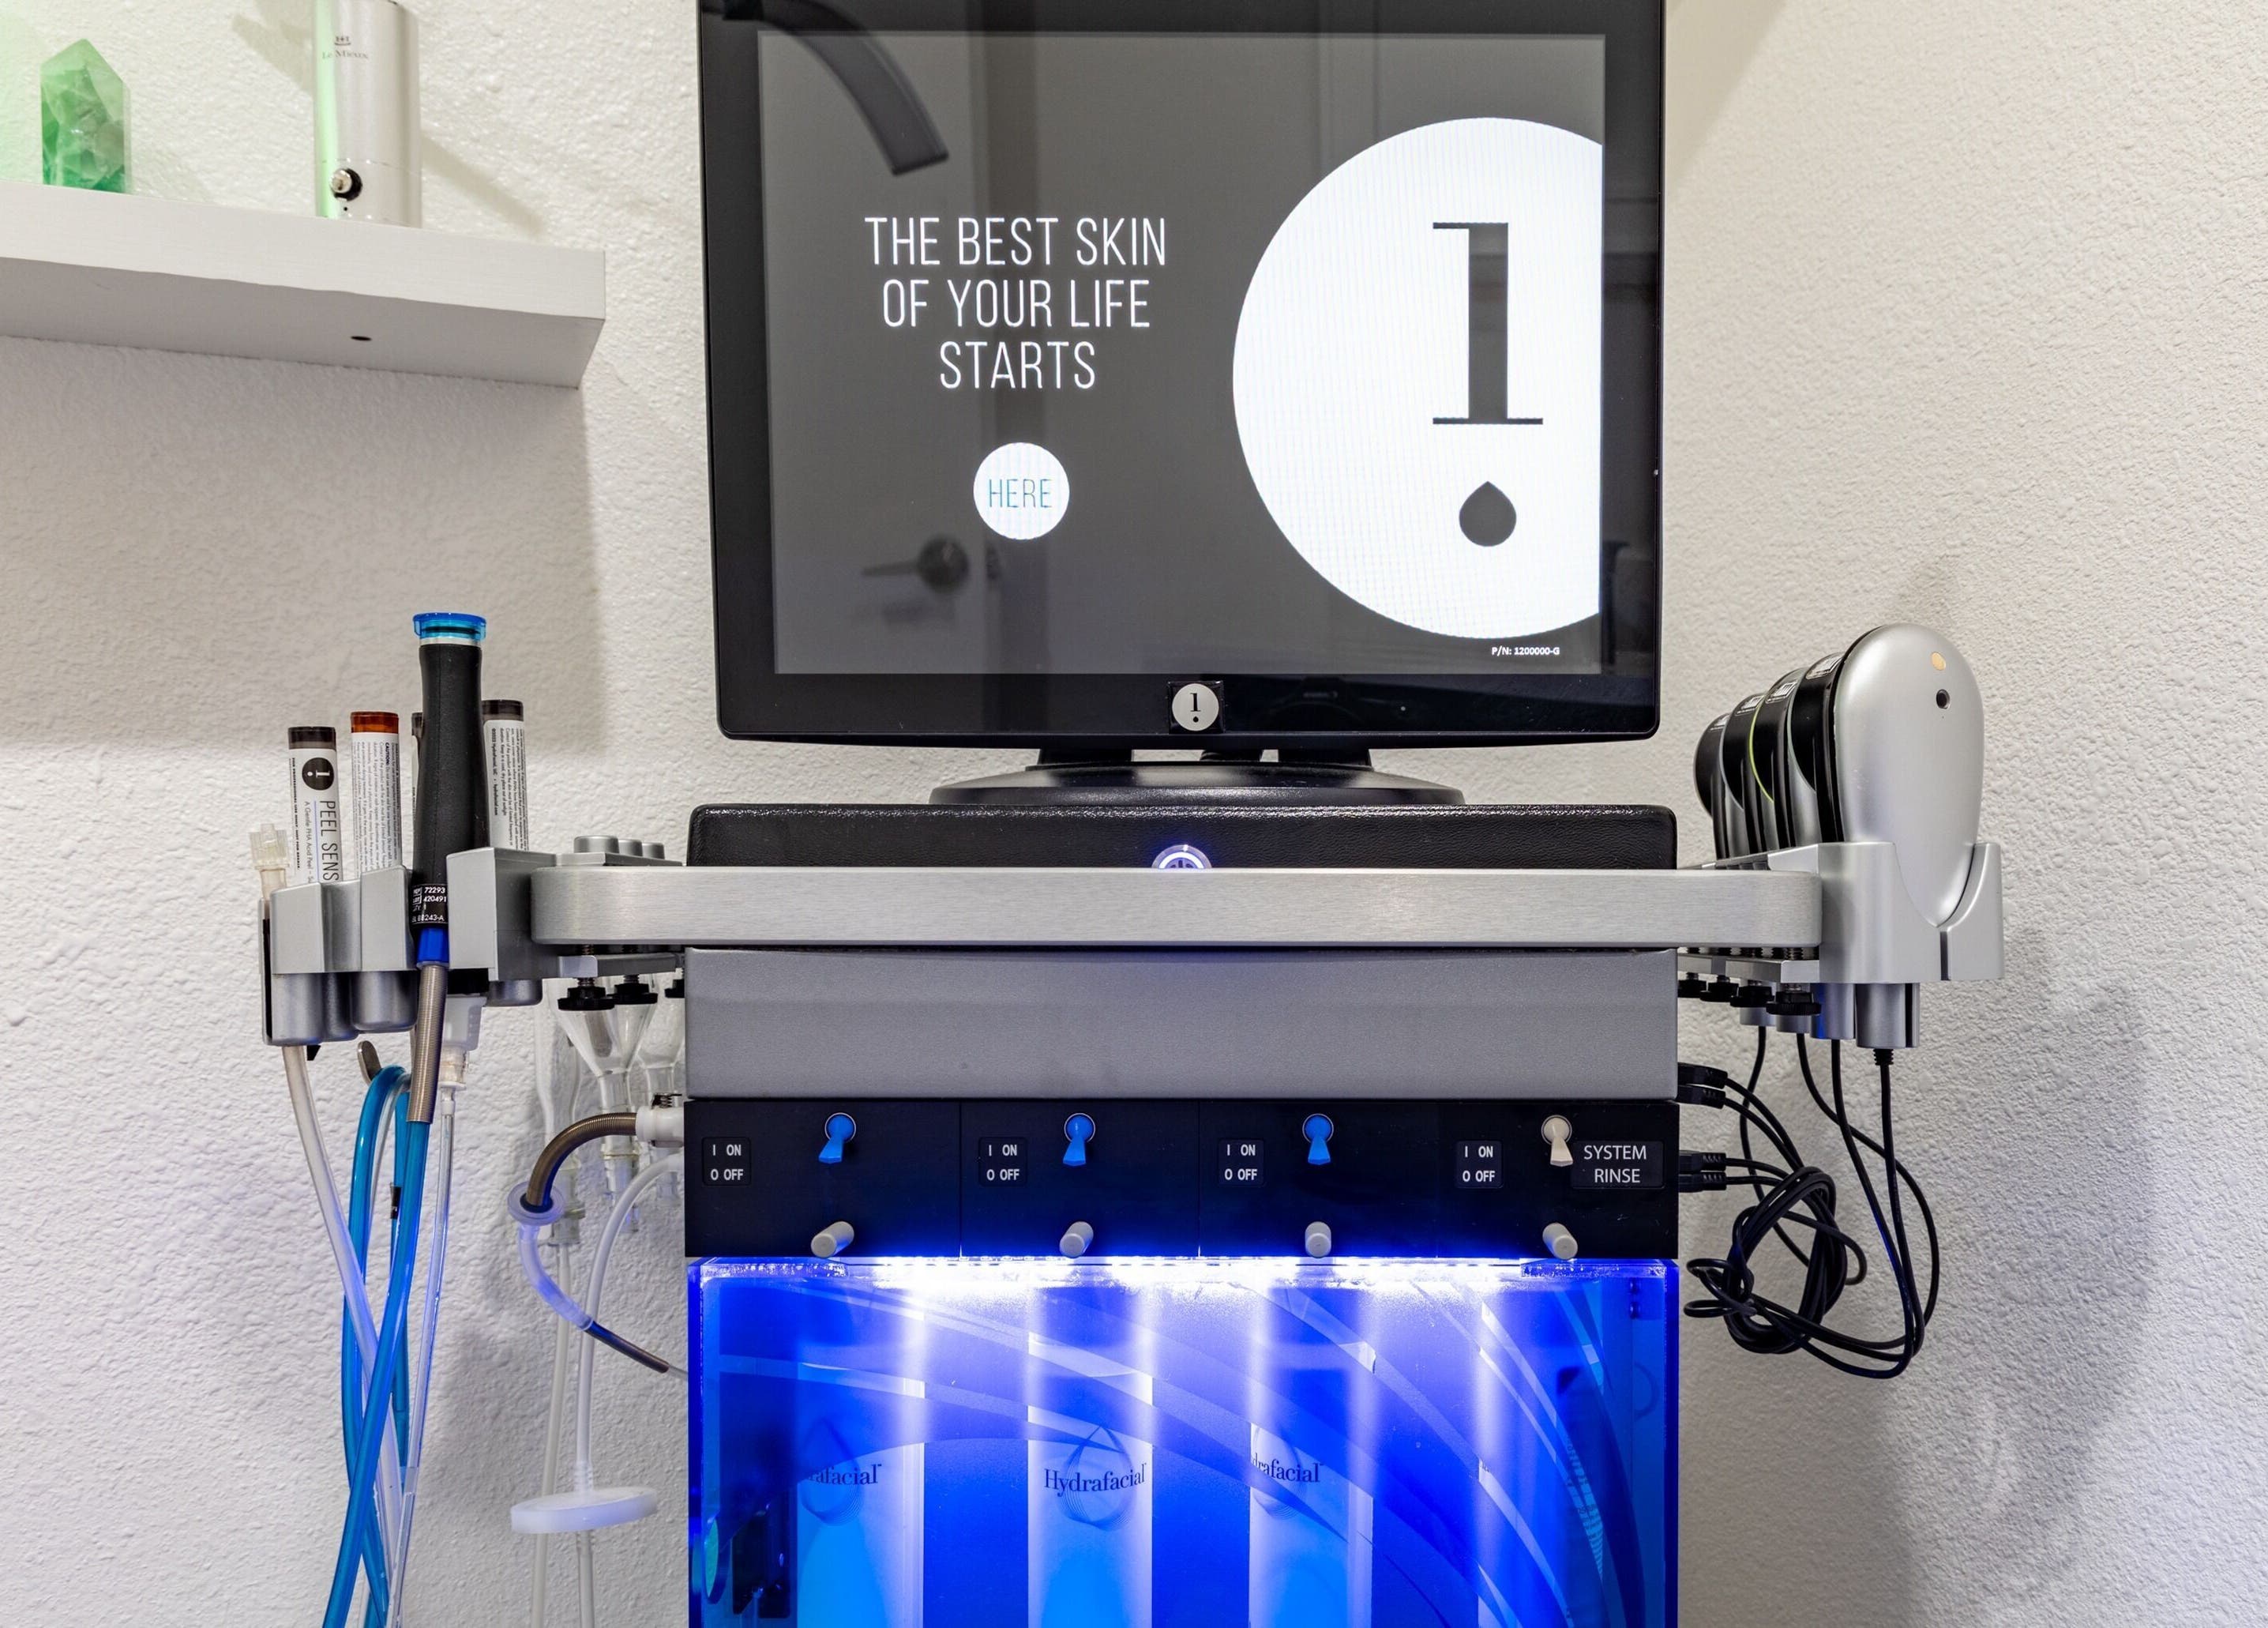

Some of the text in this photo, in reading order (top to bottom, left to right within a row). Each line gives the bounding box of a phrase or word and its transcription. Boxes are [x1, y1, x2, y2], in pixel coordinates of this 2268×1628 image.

[865, 217, 1165, 265] THE BEST SKIN
[884, 280, 1149, 327] OF YOUR LIFE
[941, 341, 1095, 389] STARTS
[989, 479, 1052, 508] HERE
[1491, 645, 1560, 656] P/N: 1200000-G
[320, 801, 339, 881] PEEL SENS
[727, 1145, 741, 1156] ON
[1003, 1145, 1017, 1156] ON
[1241, 1145, 1255, 1156] ON
[1479, 1146, 1493, 1158] ON
[1584, 1145, 1647, 1160] SYSTEM
[724, 1169, 743, 1180] OFF
[1001, 1169, 1019, 1180] OFF
[1238, 1169, 1258, 1180] OFF
[1476, 1171, 1495, 1182] OFF
[1595, 1169, 1640, 1183] RINSE
